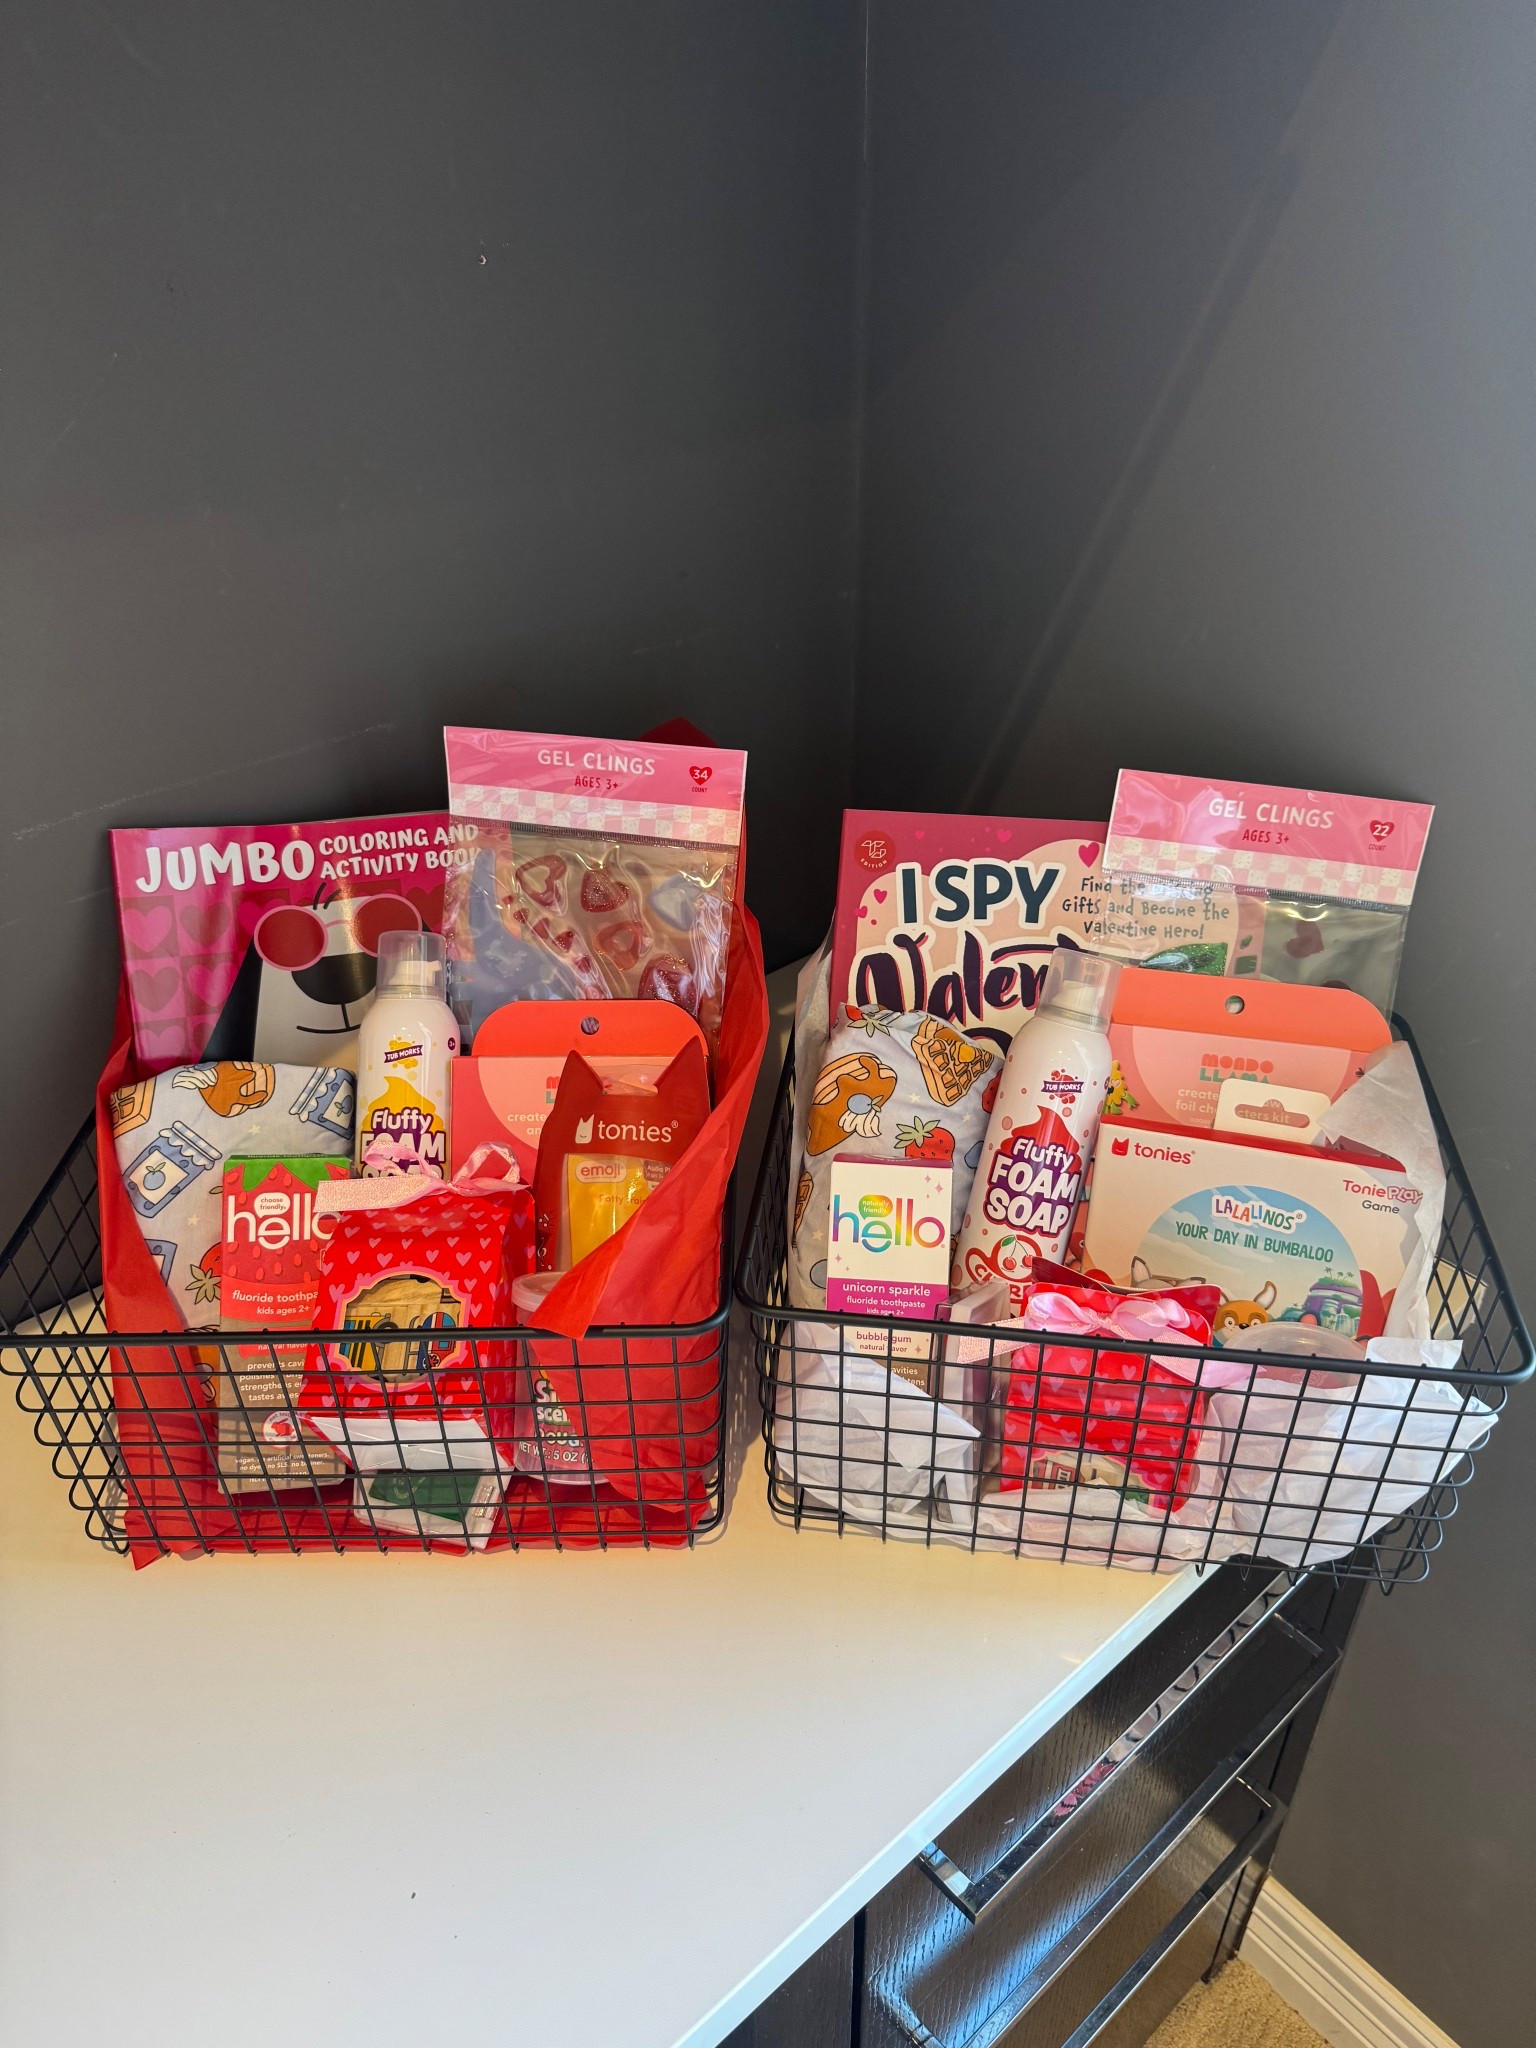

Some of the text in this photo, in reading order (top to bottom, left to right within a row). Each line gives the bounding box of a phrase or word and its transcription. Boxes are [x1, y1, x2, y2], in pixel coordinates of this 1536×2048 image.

[538, 750, 655, 775] GEL CLINGS
[693, 769, 708, 780] 34
[575, 775, 618, 790] AGES 3+
[1208, 799, 1334, 830] GEL CLINGS
[1242, 829, 1290, 844] AGES 3+
[1372, 824, 1390, 836] 22
[319, 824, 479, 856] COLORING AND
[136, 840, 315, 893] JUMBO
[320, 851, 418, 880] ACTIVITY
[860, 858, 888, 868] EDITION
[902, 863, 1060, 924] I SPY
[1062, 896, 1102, 915] Gifts
[387, 1047, 420, 1060] TUB WORKS
[1178, 1088, 1220, 1100] create
[1176, 1099, 1196, 1112] foil
[373, 1108, 432, 1134] Fluffy
[508, 1112, 546, 1122] create
[1013, 1138, 1074, 1172] Fluffy
[581, 1164, 621, 1178] emoji
[991, 1155, 1080, 1203] FOAM
[986, 1188, 1070, 1234] SOAP
[1362, 1200, 1400, 1214] Game
[228, 1192, 341, 1250] hello
[1176, 1221, 1334, 1263] YOUR DAY IN BUMBALOO
[232, 1290, 318, 1303] fluoride toothpa
[842, 1282, 931, 1297] unicorn sparkle
[846, 1296, 926, 1308] fluoride toothpaste
[256, 1306, 274, 1314] kids
[276, 1307, 296, 1316] ages
[267, 1454, 292, 1462] artificial
[520, 1442, 531, 1454] NET
[553, 1450, 560, 1460] 5
[562, 1452, 578, 1462] OZ
